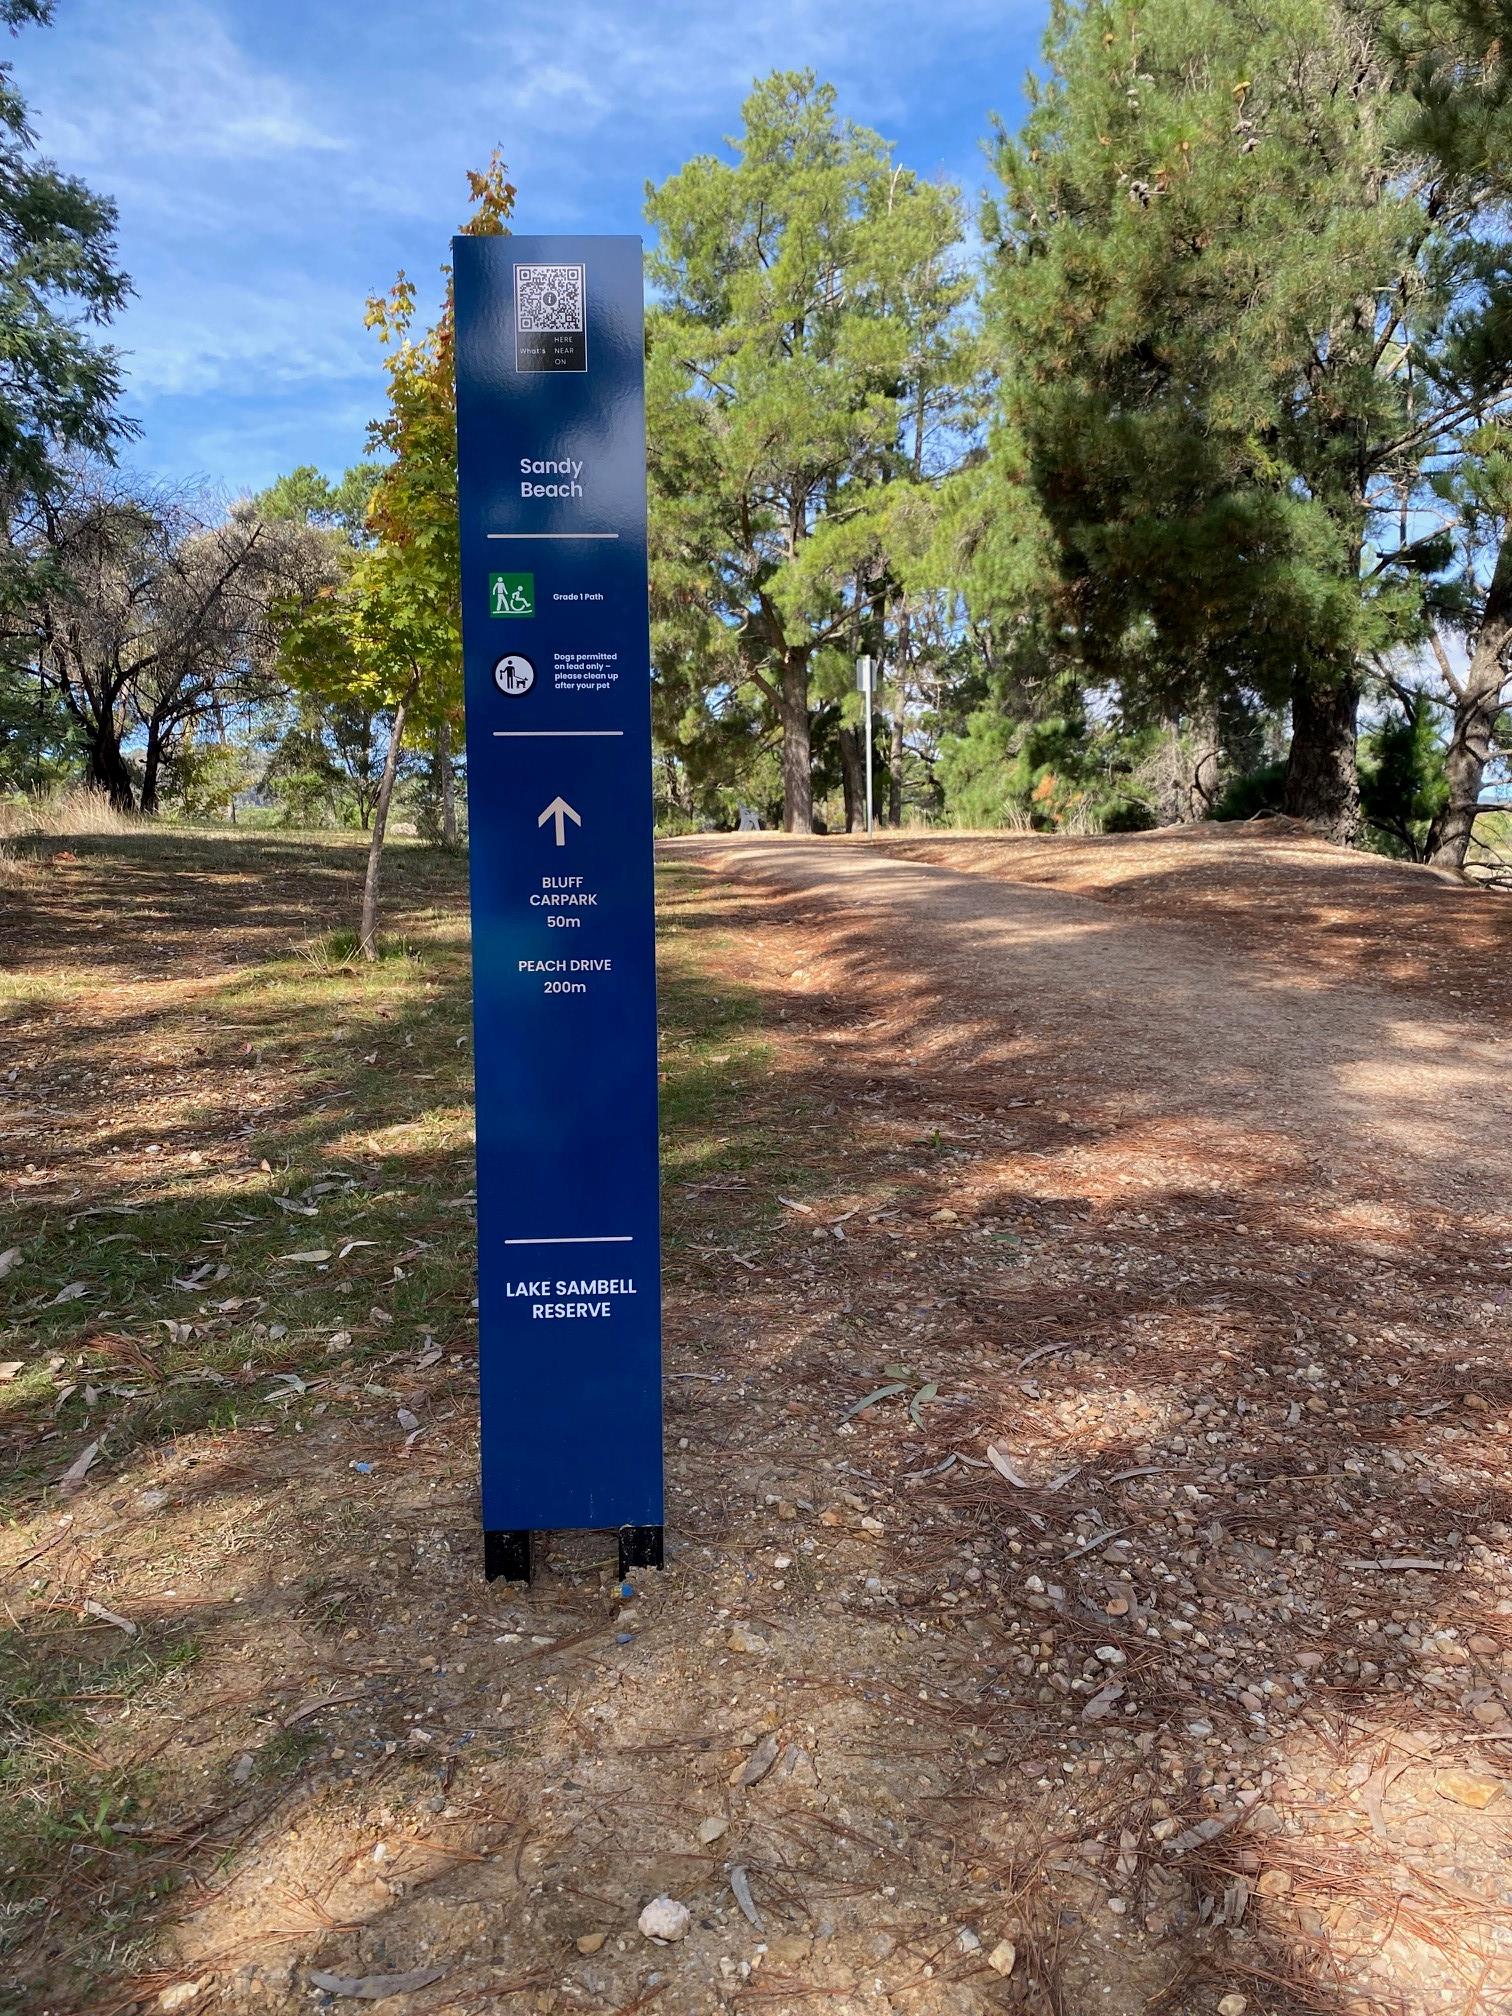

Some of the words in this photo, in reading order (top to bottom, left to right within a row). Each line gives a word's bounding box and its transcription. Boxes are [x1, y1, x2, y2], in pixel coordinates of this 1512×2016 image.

[520, 458, 583, 478] Sandy
[520, 481, 583, 498] Beach
[553, 593, 578, 601] Grade
[584, 593, 604, 601] Path
[554, 653, 575, 662] Dogs
[577, 653, 617, 662] permitted
[566, 662, 585, 670] lead
[586, 662, 603, 672] only
[555, 672, 582, 681] please
[583, 672, 606, 680] clean
[608, 673, 619, 681] up
[596, 682, 610, 691] pet
[542, 876, 583, 889] BLUFF
[530, 894, 598, 906] CARPARK
[547, 916, 581, 928] 50m
[518, 960, 566, 972] PEACH
[570, 959, 612, 971] DRIVE
[544, 982, 587, 993] 200m
[506, 1281, 551, 1297] LAKE
[556, 1278, 637, 1295] SAMBELL
[532, 1302, 611, 1319] RESERVE
